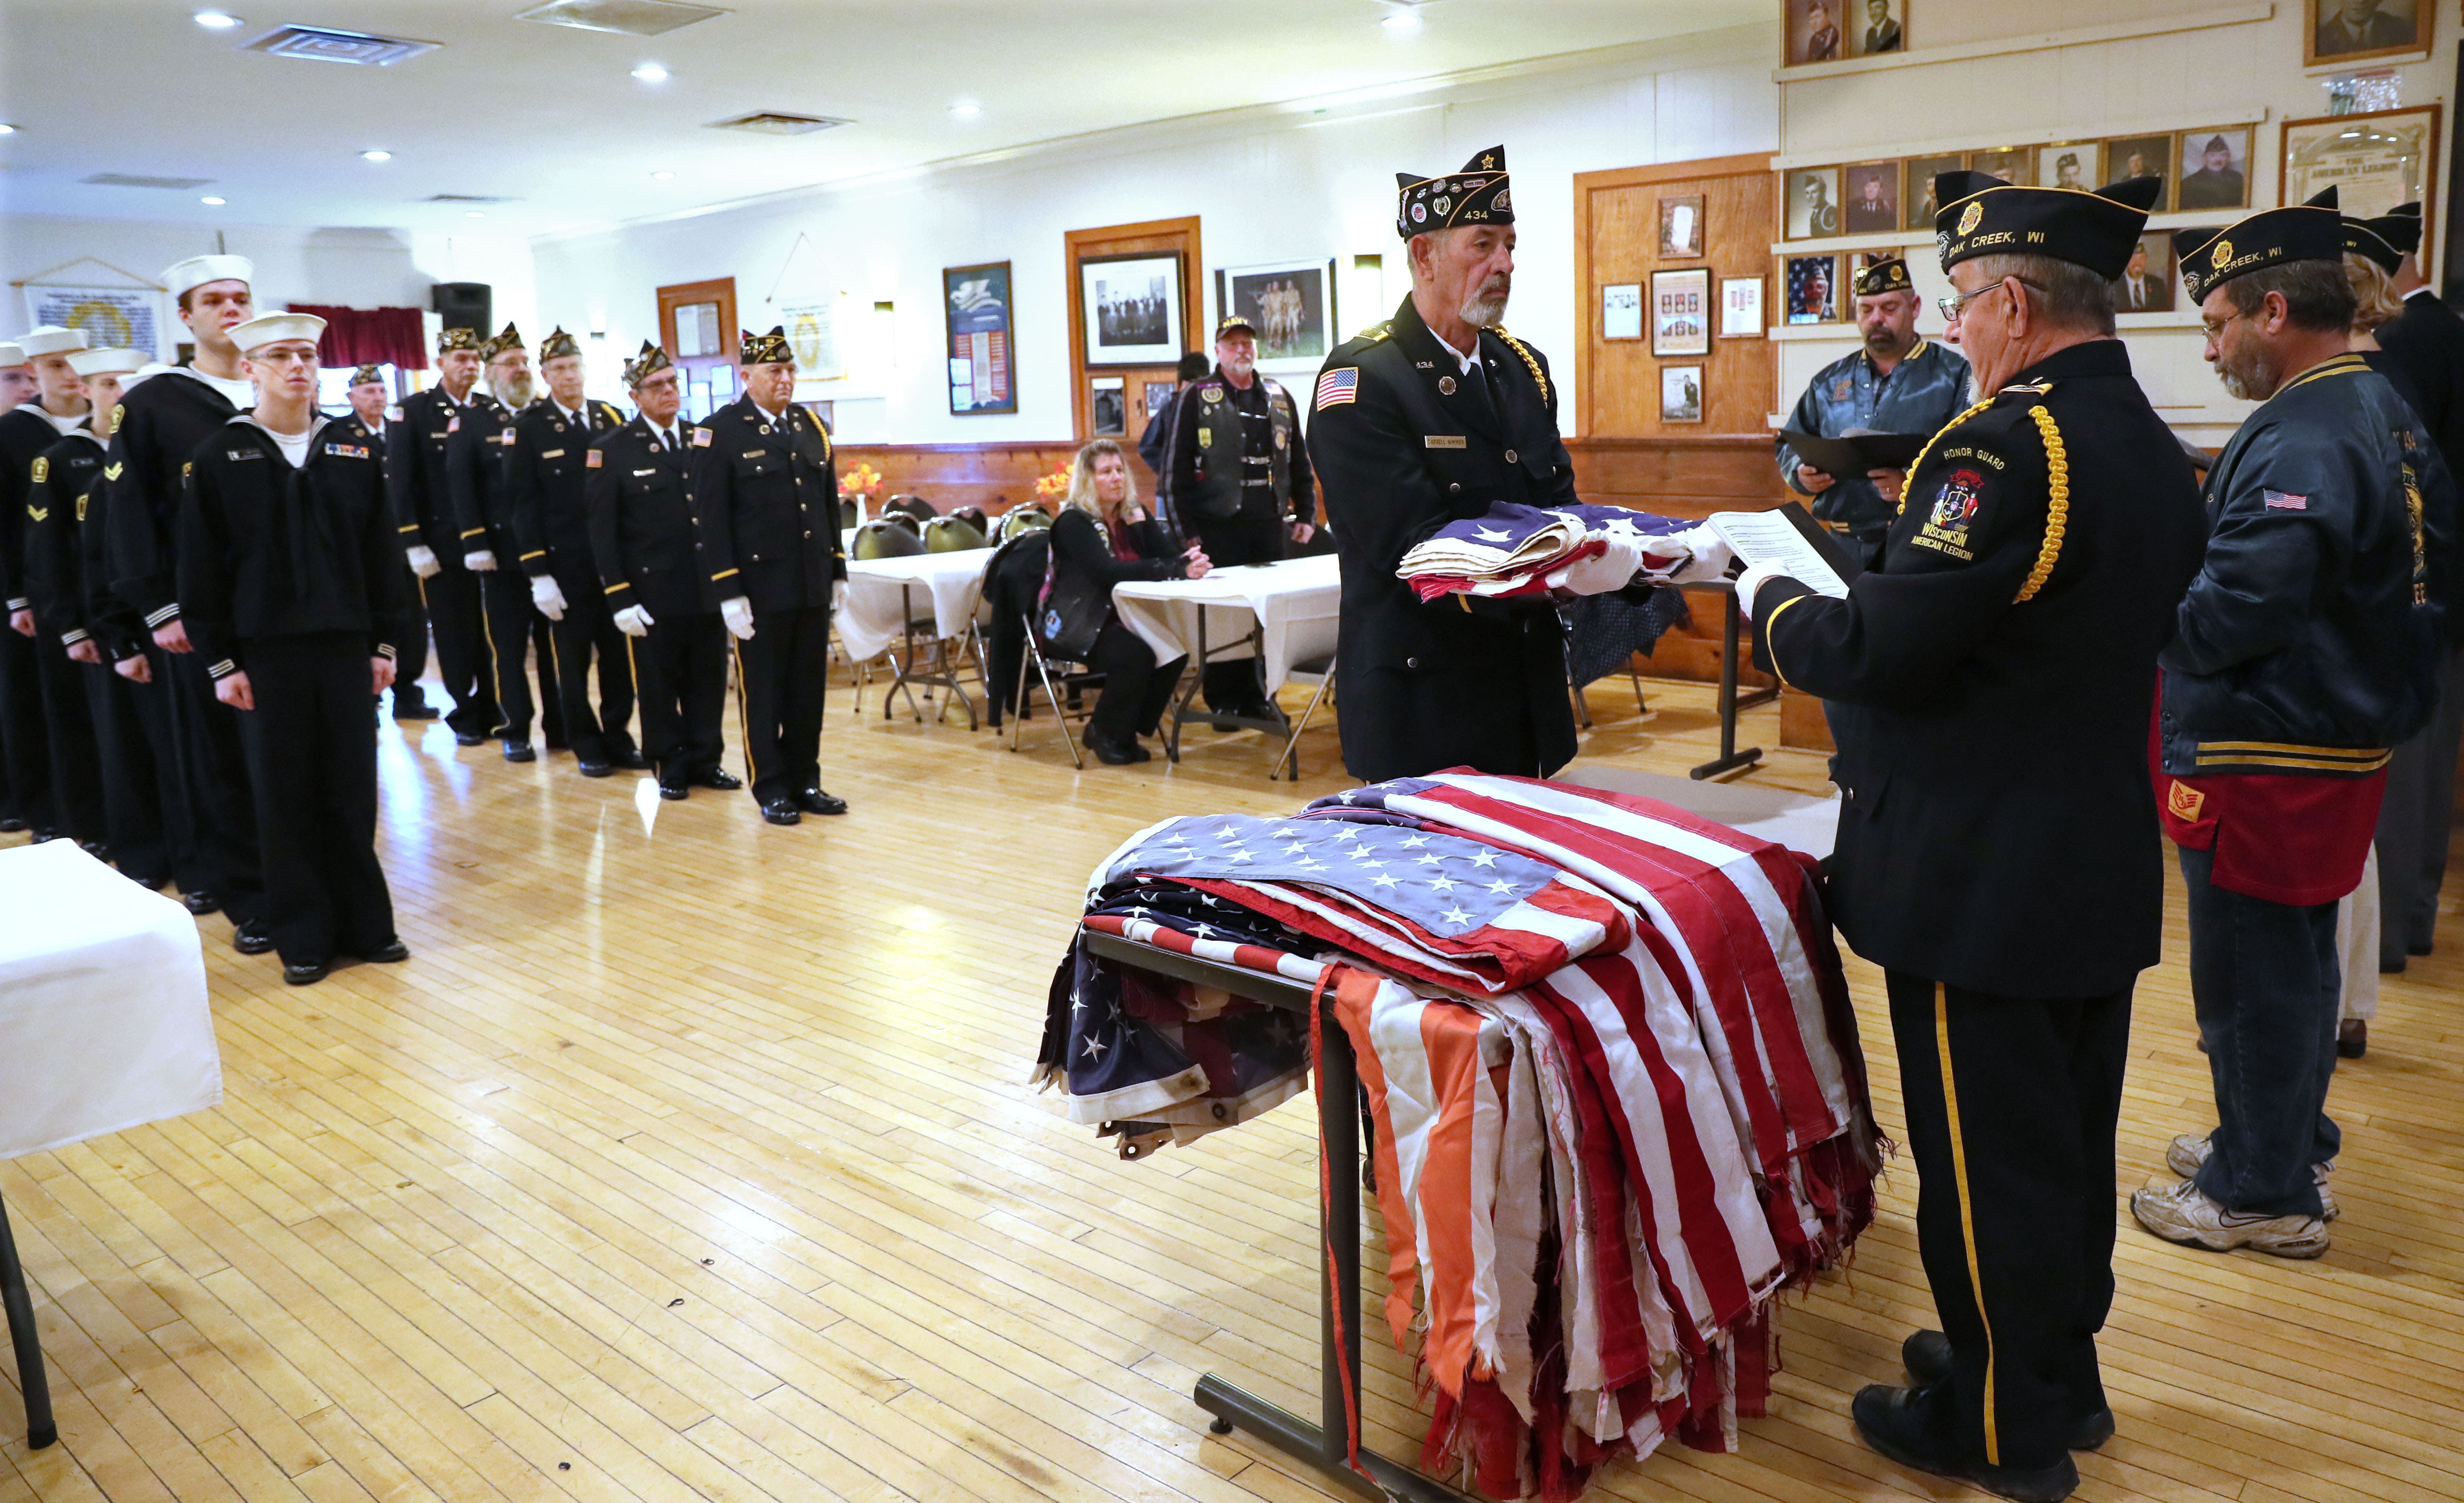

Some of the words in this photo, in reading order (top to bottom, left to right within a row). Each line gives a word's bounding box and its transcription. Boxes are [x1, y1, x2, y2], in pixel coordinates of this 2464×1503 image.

[1464, 210, 1489, 220] 434
[1949, 241, 1966, 258] OAK
[1971, 231, 2016, 248] CREEK,
[2028, 231, 2045, 243] WI
[2204, 270, 2220, 287] OAK
[2224, 252, 2264, 273] CREEK,
[2268, 246, 2282, 258] WI
[1222, 316, 1249, 329] NAVY
[1943, 448, 1972, 460] HONOR
[1977, 450, 2005, 470] GUARD
[1921, 522, 1968, 547] WISCONSIN
[1911, 535, 1944, 550] AMERICAN
[1944, 543, 1974, 561] LEGION
